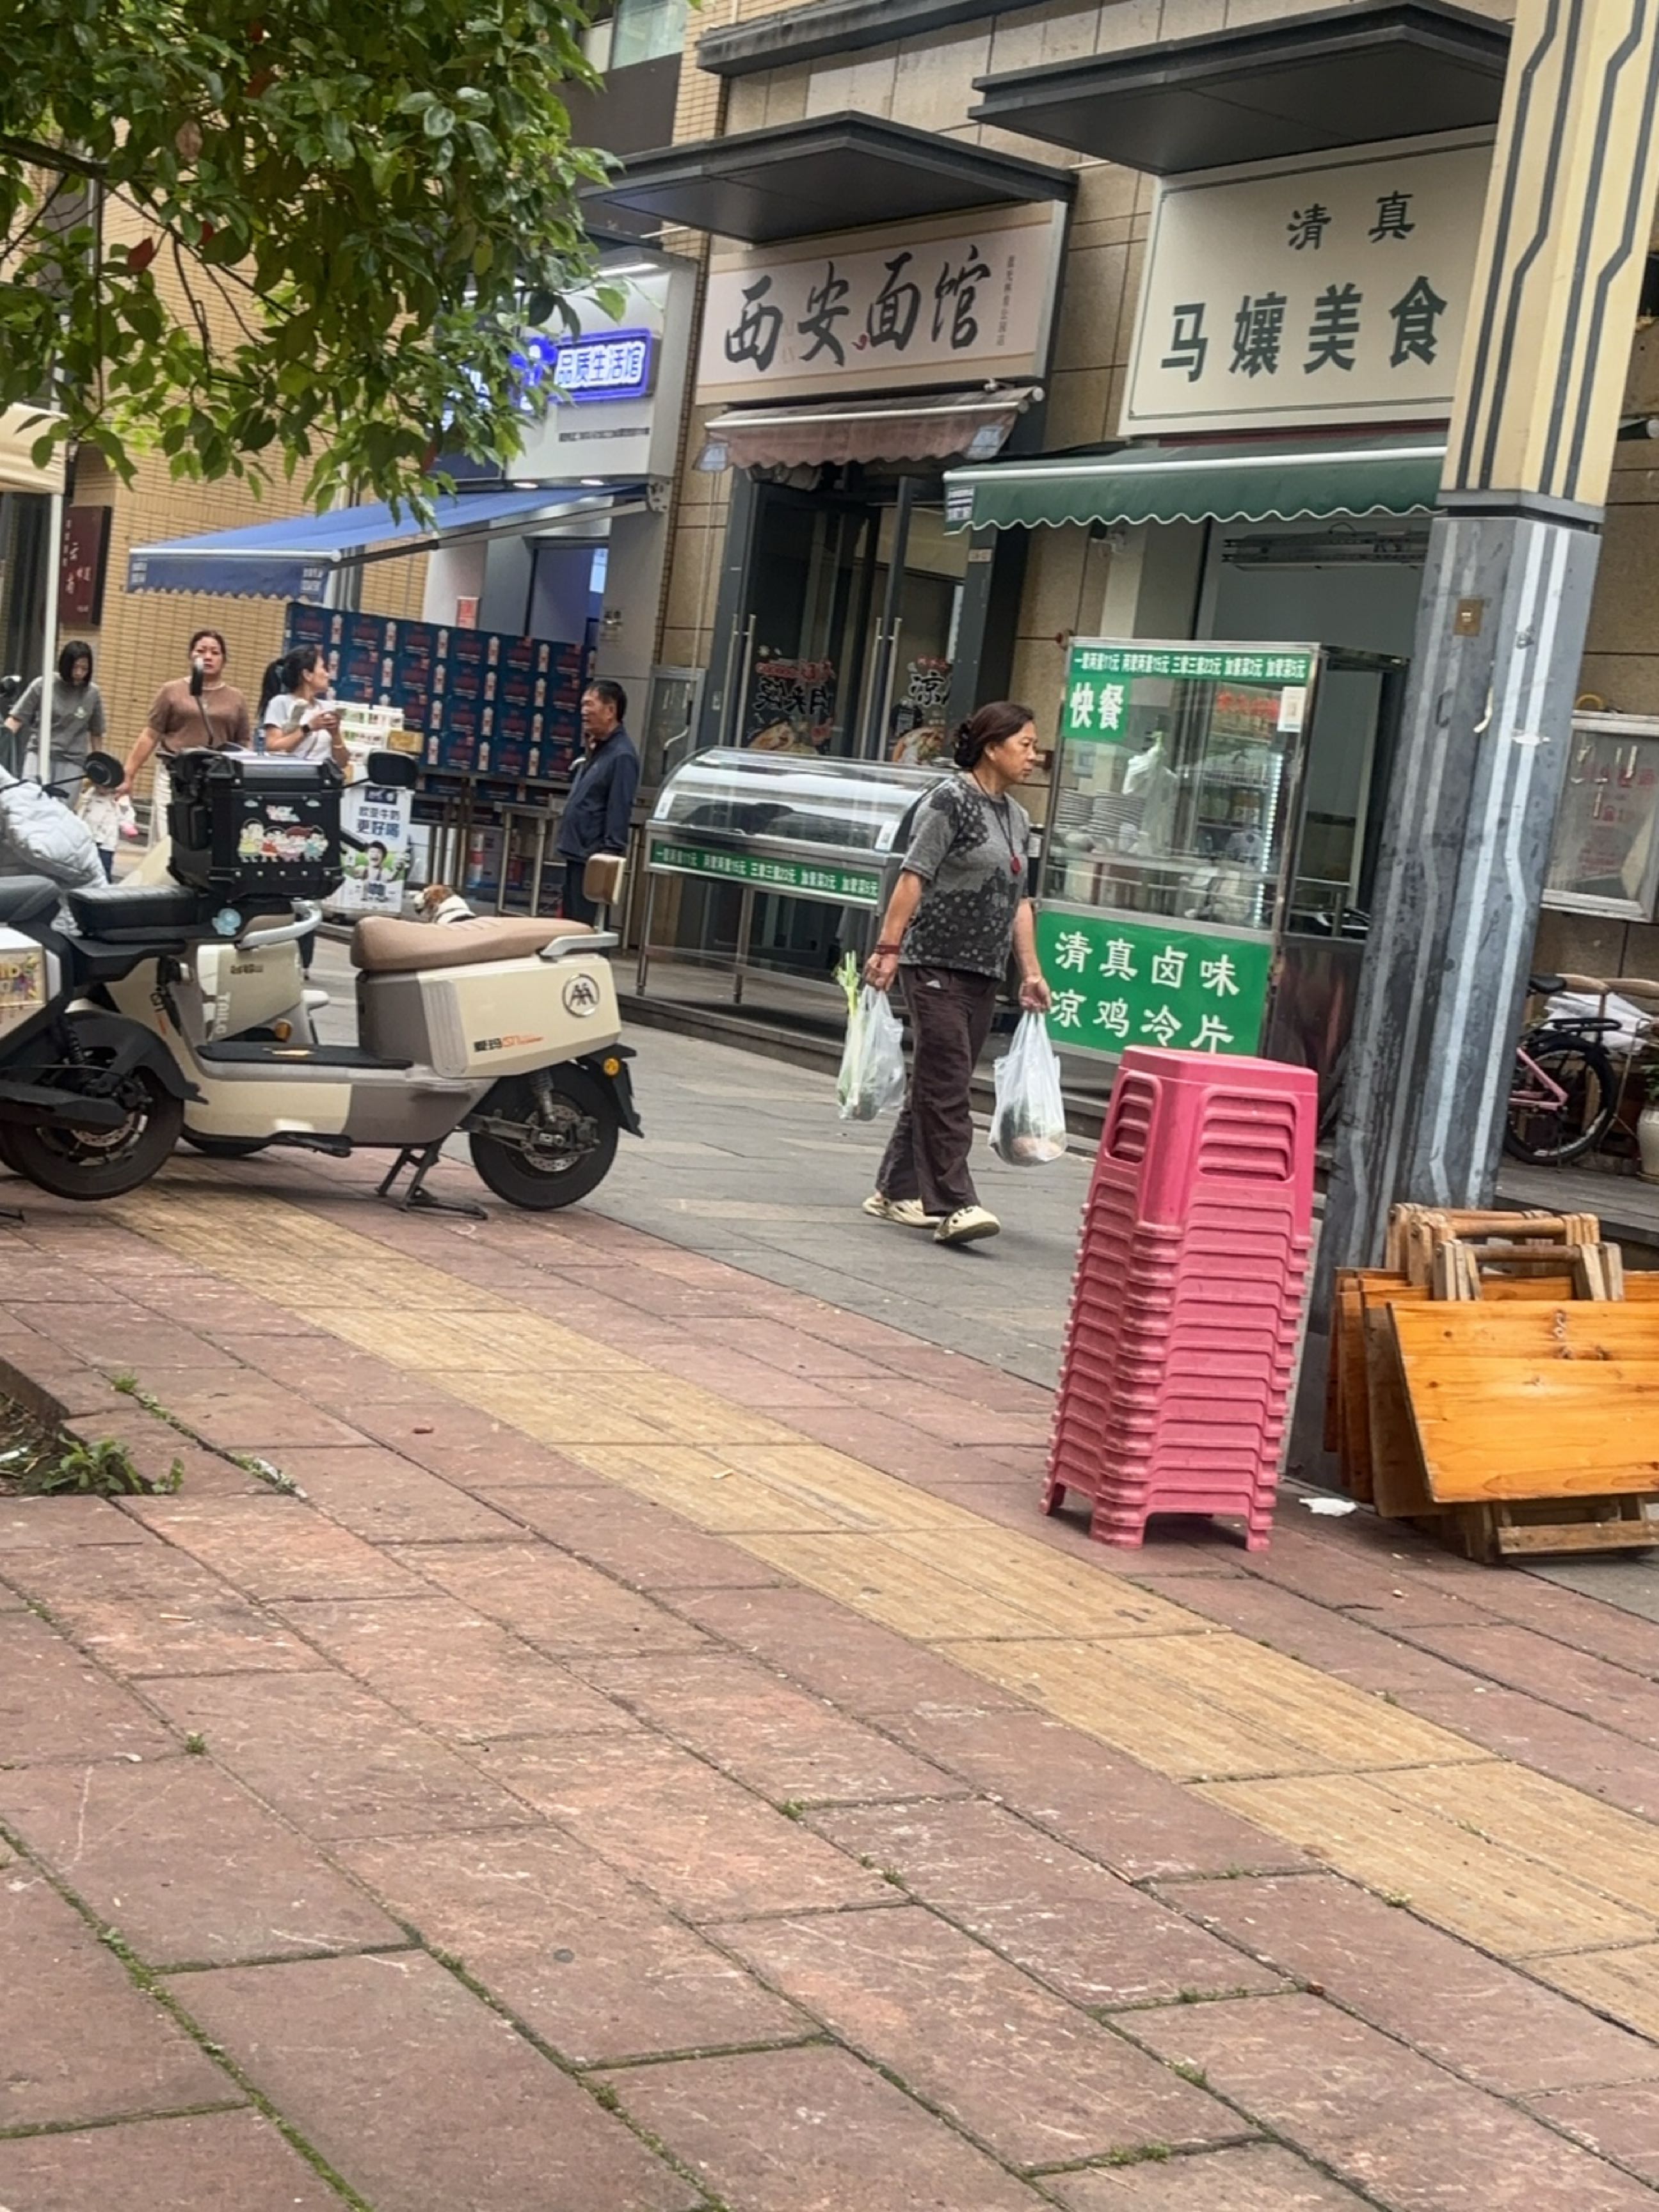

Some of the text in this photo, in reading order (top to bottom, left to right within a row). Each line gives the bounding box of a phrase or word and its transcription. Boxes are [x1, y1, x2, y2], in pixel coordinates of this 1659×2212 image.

[1286, 190, 1415, 250] 清真
[724, 244, 991, 372] 西安面馆
[1161, 276, 1448, 383] 马孃美食
[555, 342, 646, 387] 品质生活馆
[1070, 682, 1125, 730] 快餐
[1054, 931, 1240, 997] 清真卤味
[1051, 989, 1235, 1054] 凉鸡冷片
